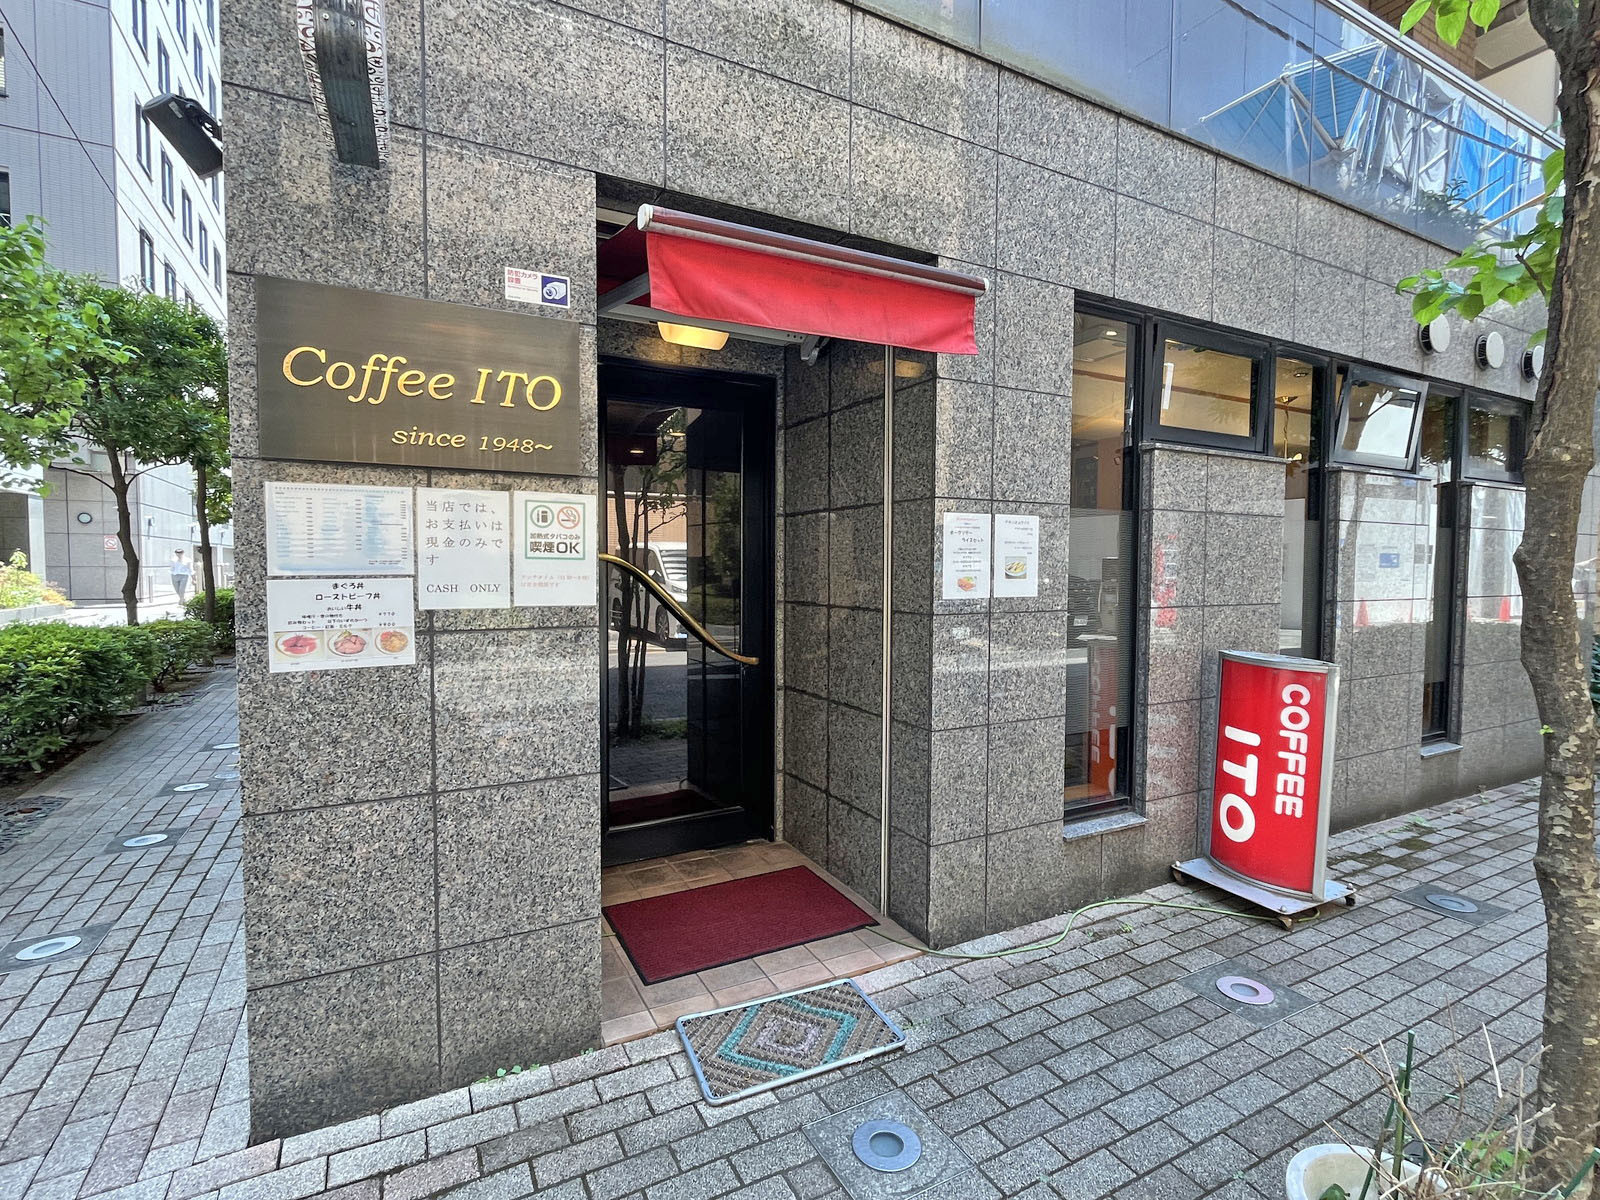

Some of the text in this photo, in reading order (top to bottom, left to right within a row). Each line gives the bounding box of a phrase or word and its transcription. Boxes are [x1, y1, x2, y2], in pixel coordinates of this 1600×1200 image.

[282, 346, 562, 411] Coffee ITO
[391, 426, 466, 448] since
[426, 500, 496, 514] 当店では、
[426, 518, 503, 531] お支払いは
[426, 536, 503, 548] 現金のみで
[530, 532, 580, 540] 加熱式タバコのみ
[530, 541, 580, 554] 喫煙OK
[426, 554, 439, 565] す
[332, 582, 364, 590] まぐろ丼
[426, 583, 501, 593] CASH ONLY
[315, 592, 381, 601] ローストビーフ丼
[1274, 683, 1311, 819] COFFEE
[1219, 725, 1261, 843] ITO
